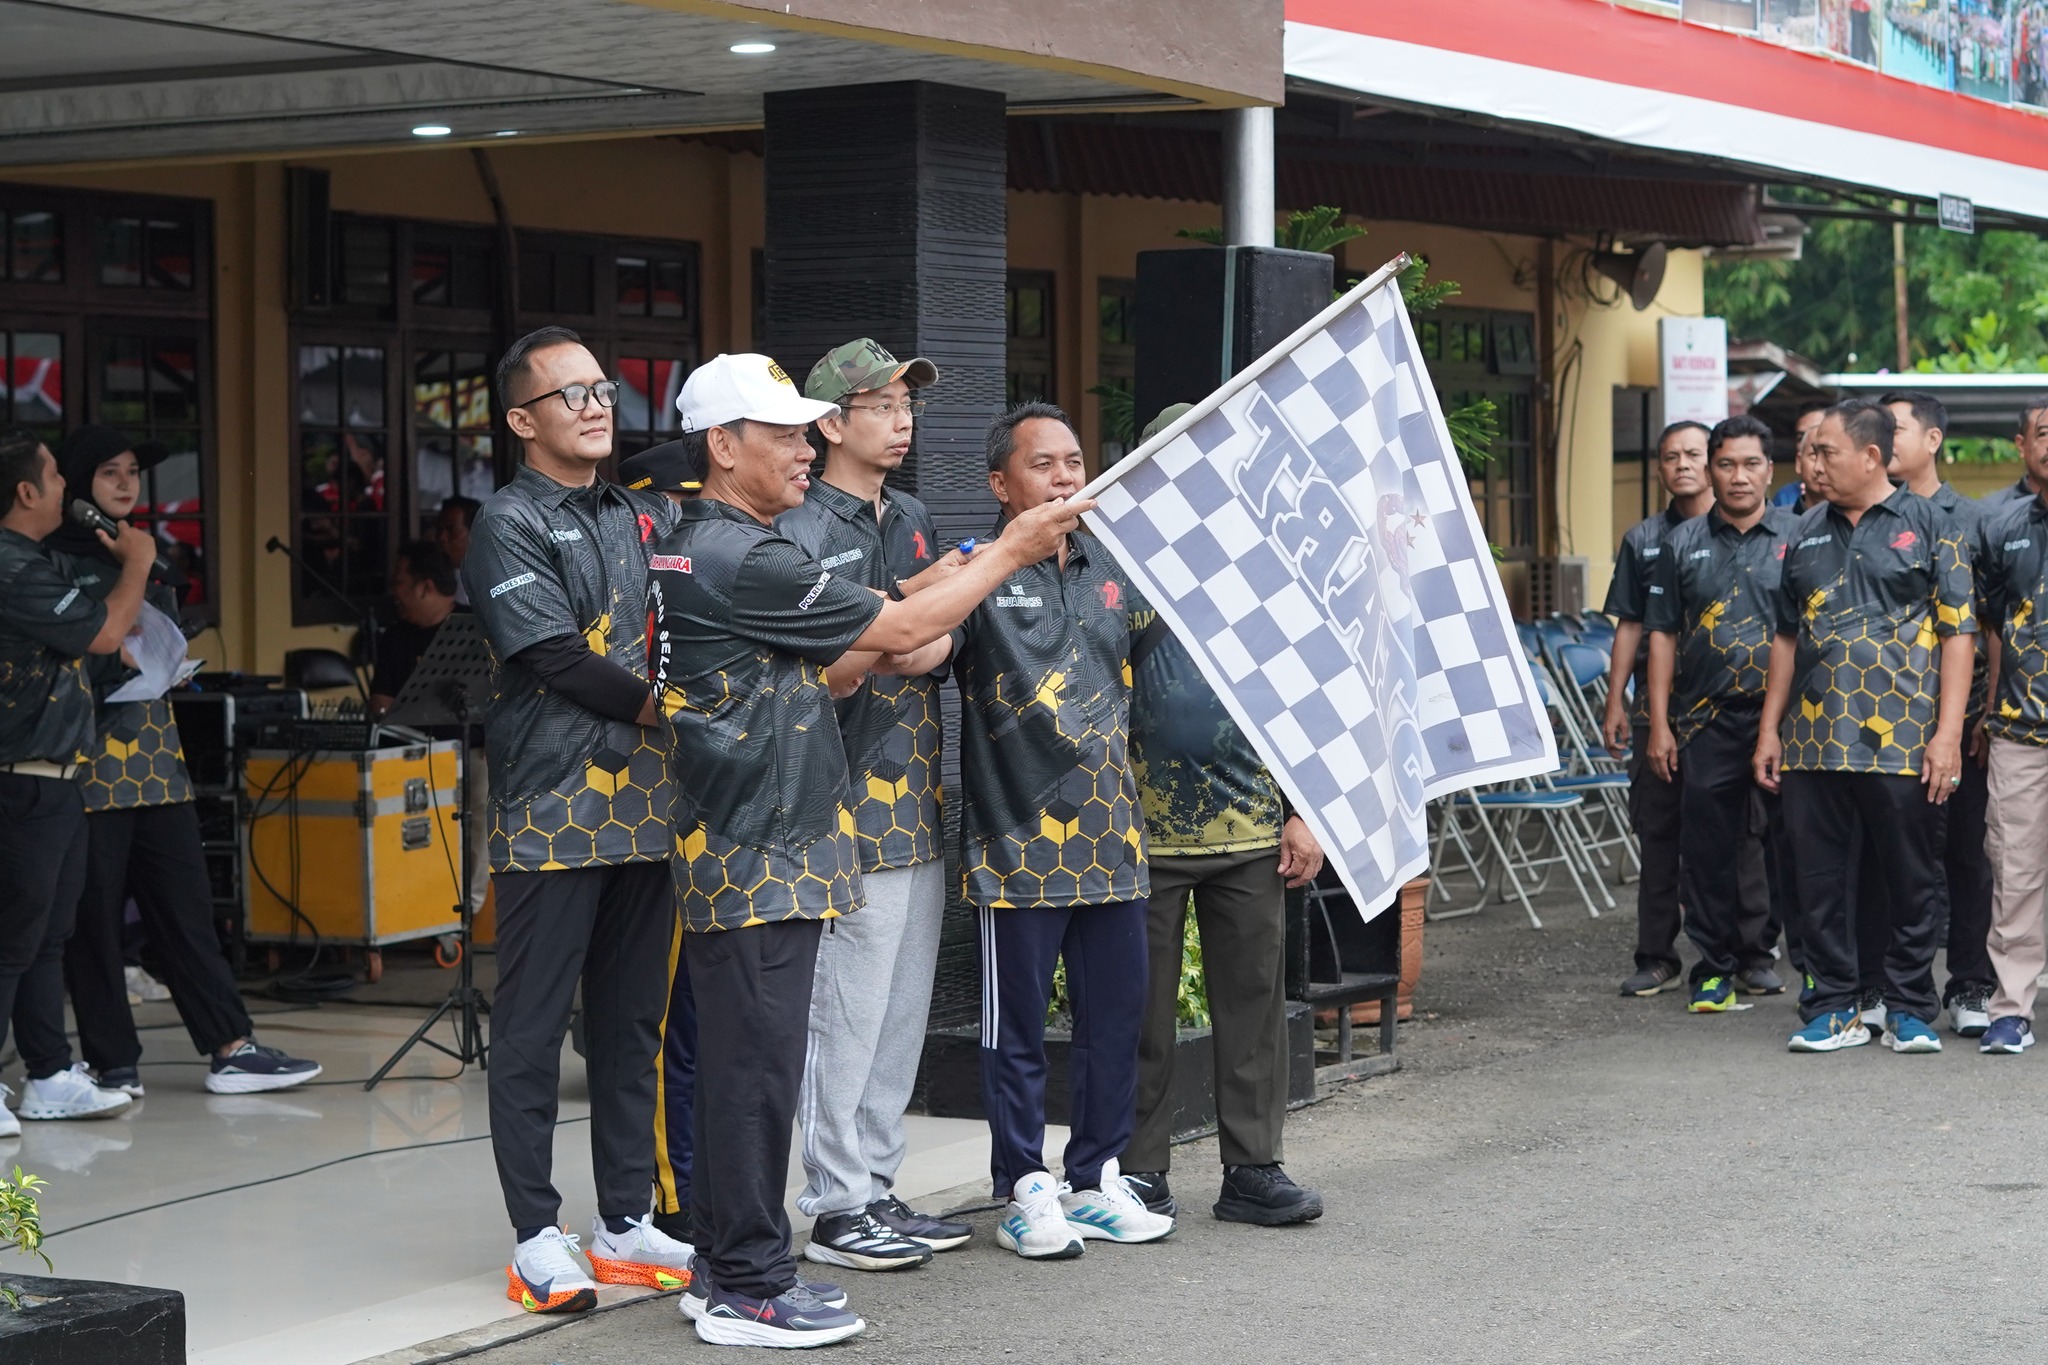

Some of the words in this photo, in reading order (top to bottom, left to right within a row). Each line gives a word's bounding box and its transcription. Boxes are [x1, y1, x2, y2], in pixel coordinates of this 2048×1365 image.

[490, 577, 519, 597] POLRES
[518, 572, 536, 586] HSS
[800, 579, 825, 609] POLRES
